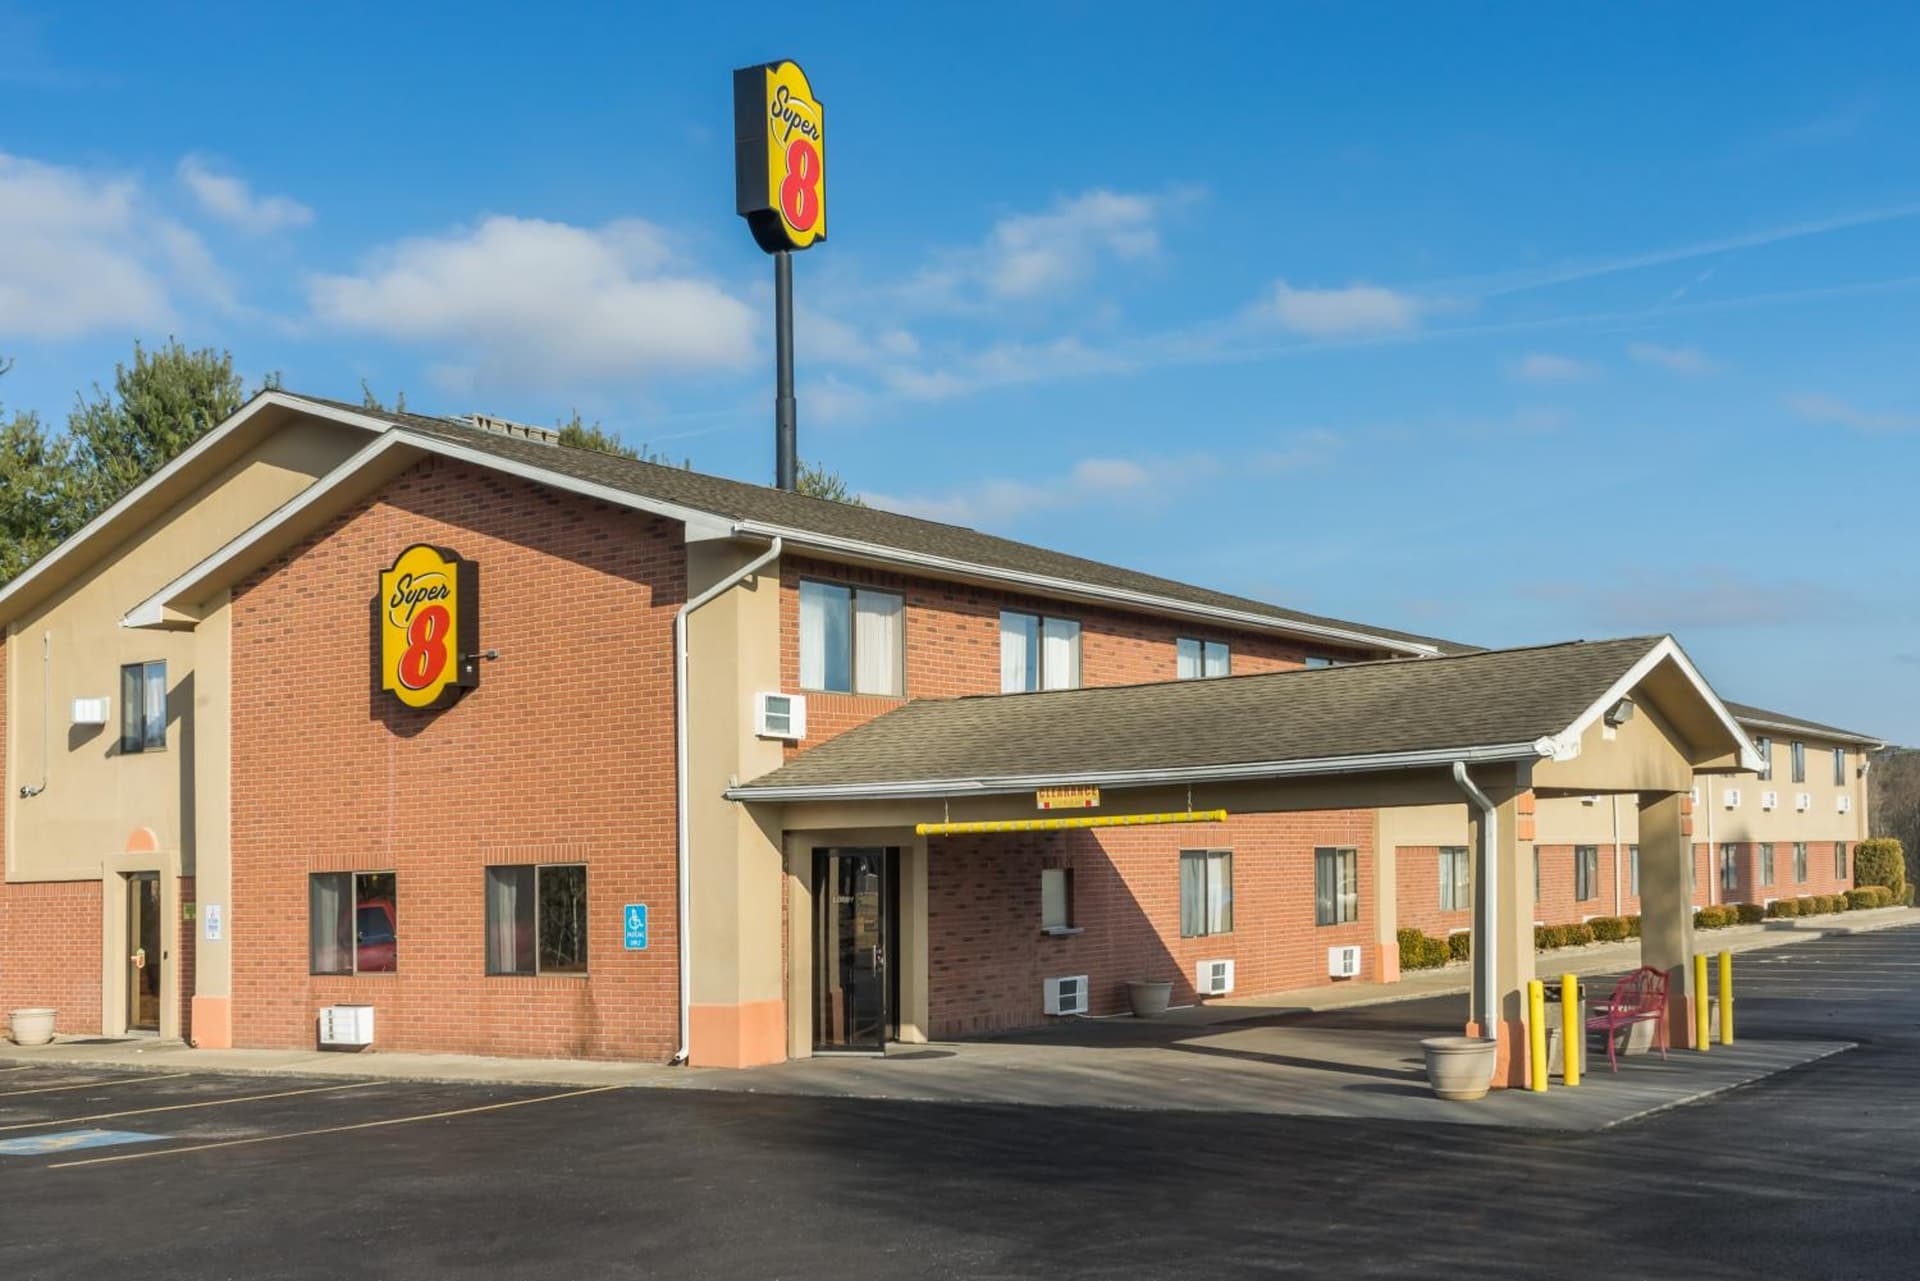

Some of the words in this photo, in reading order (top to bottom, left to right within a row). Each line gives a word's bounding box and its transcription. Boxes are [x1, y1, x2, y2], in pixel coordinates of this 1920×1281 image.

[771, 85, 820, 142] Super
[779, 138, 820, 233] 8
[390, 573, 450, 622] Super
[398, 604, 451, 691] 8
